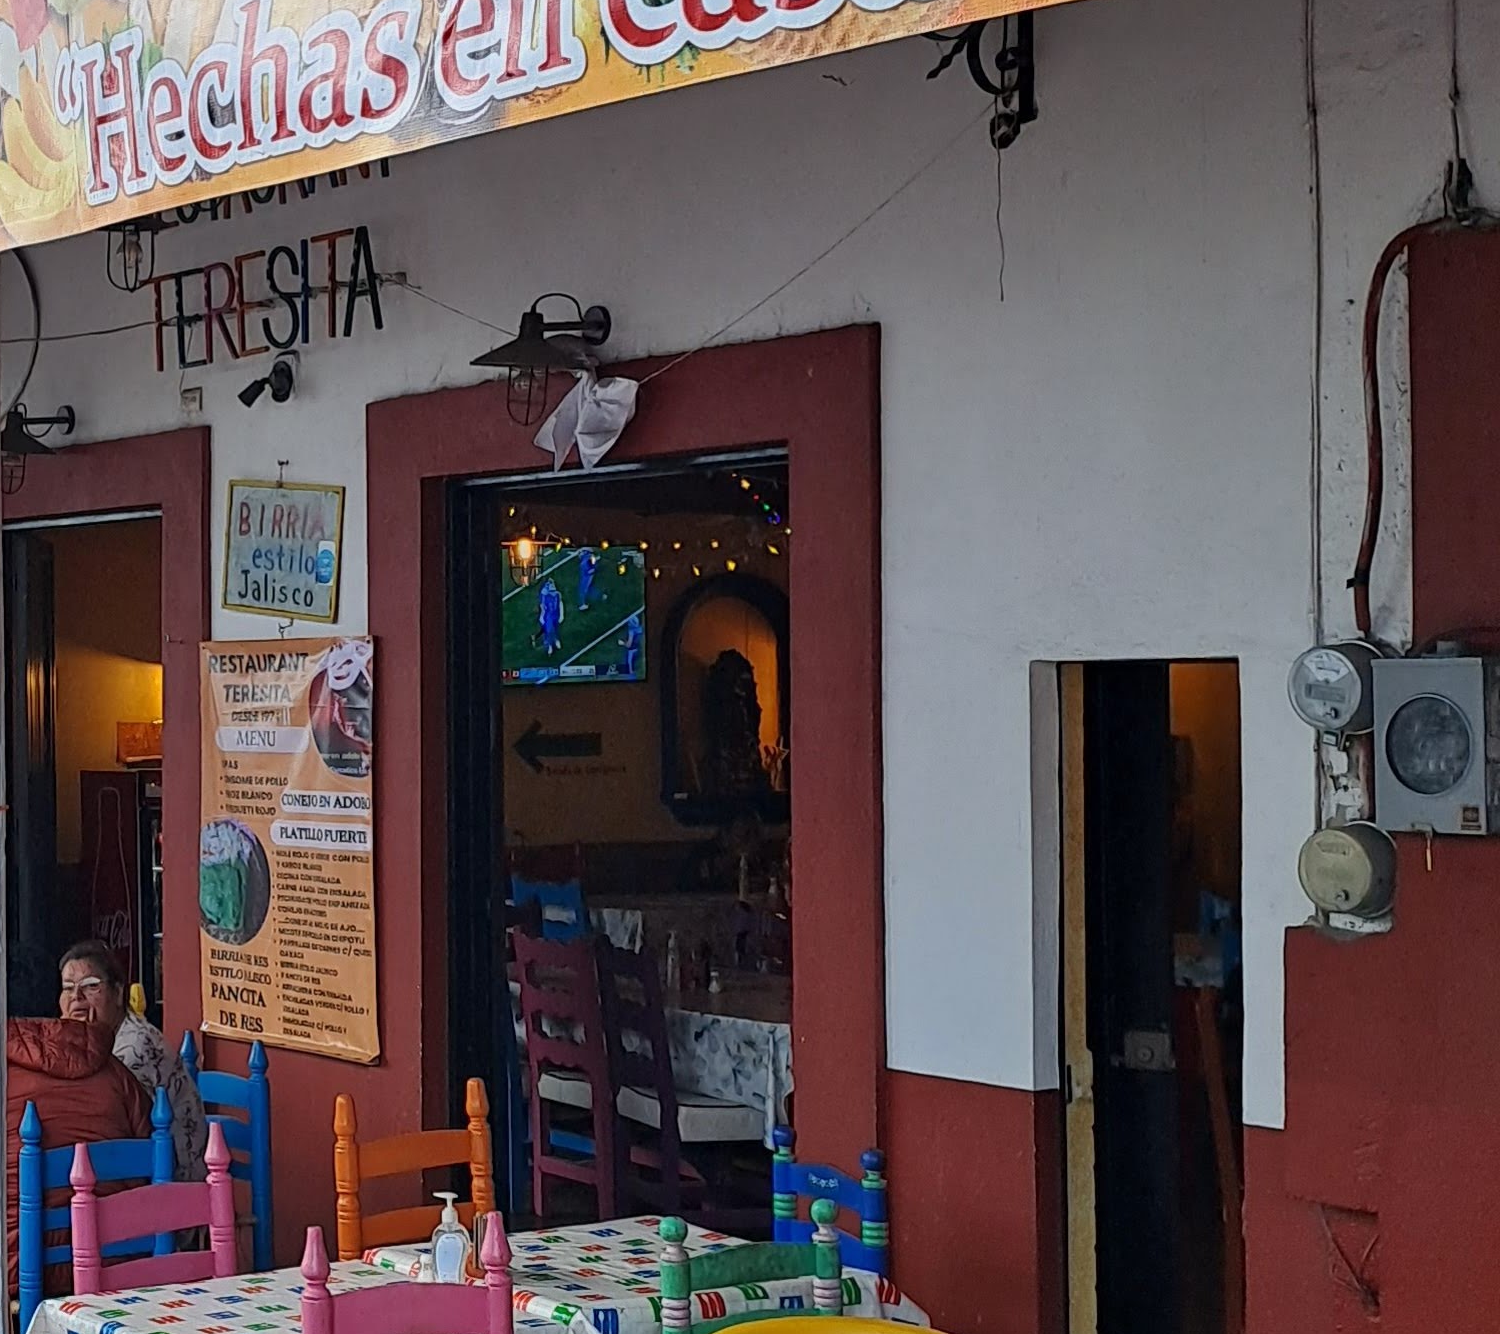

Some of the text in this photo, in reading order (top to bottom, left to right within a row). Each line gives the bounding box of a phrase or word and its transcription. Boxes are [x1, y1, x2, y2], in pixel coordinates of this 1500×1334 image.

[139, 225, 384, 372] TERESITA
[238, 501, 326, 540] BIRRIA
[252, 544, 316, 575] estilo
[238, 569, 314, 607] Jalisco
[208, 652, 309, 675] RESTAURANT
[223, 683, 292, 703] TERESITA
[281, 793, 317, 808] CONEJO
[280, 826, 323, 843] PLATILLO
[211, 982, 267, 1008] PANCITA
[219, 1009, 264, 1033] DE RES
